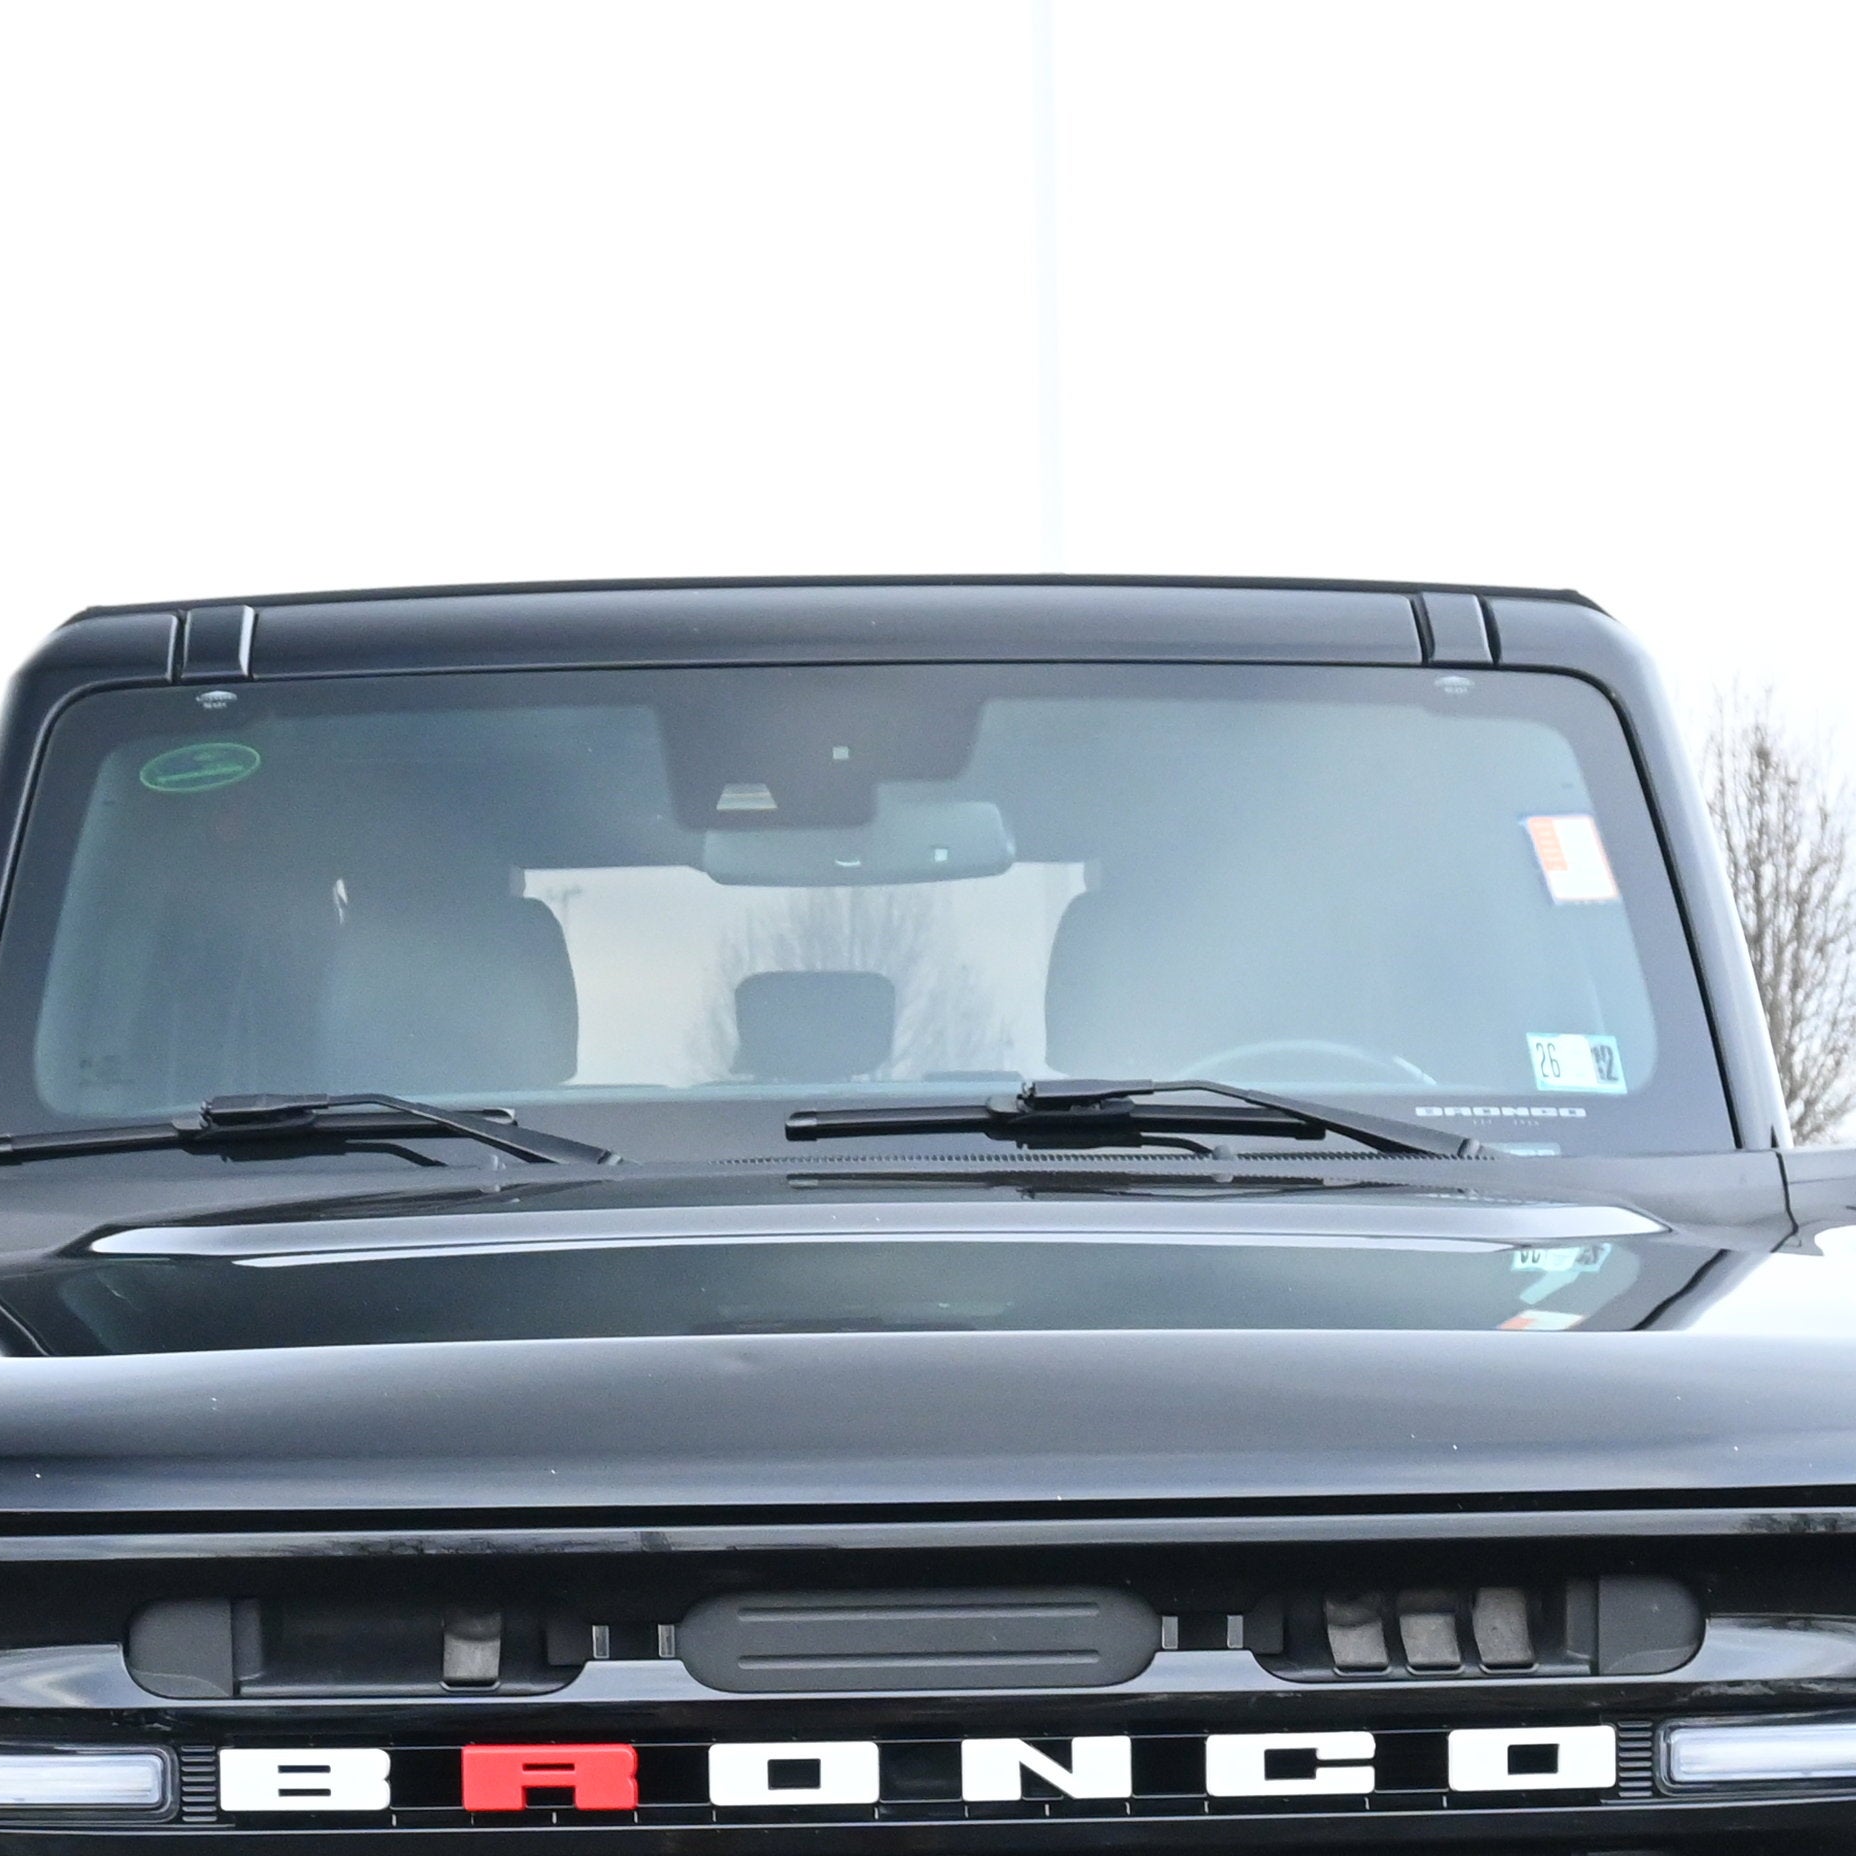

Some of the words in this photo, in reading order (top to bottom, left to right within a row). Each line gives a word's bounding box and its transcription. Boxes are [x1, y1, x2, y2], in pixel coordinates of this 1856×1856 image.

[1536, 1042, 1561, 1077] 26
[1415, 1106, 1587, 1118] BRONCO
[219, 1724, 1617, 1812] BRONCO
